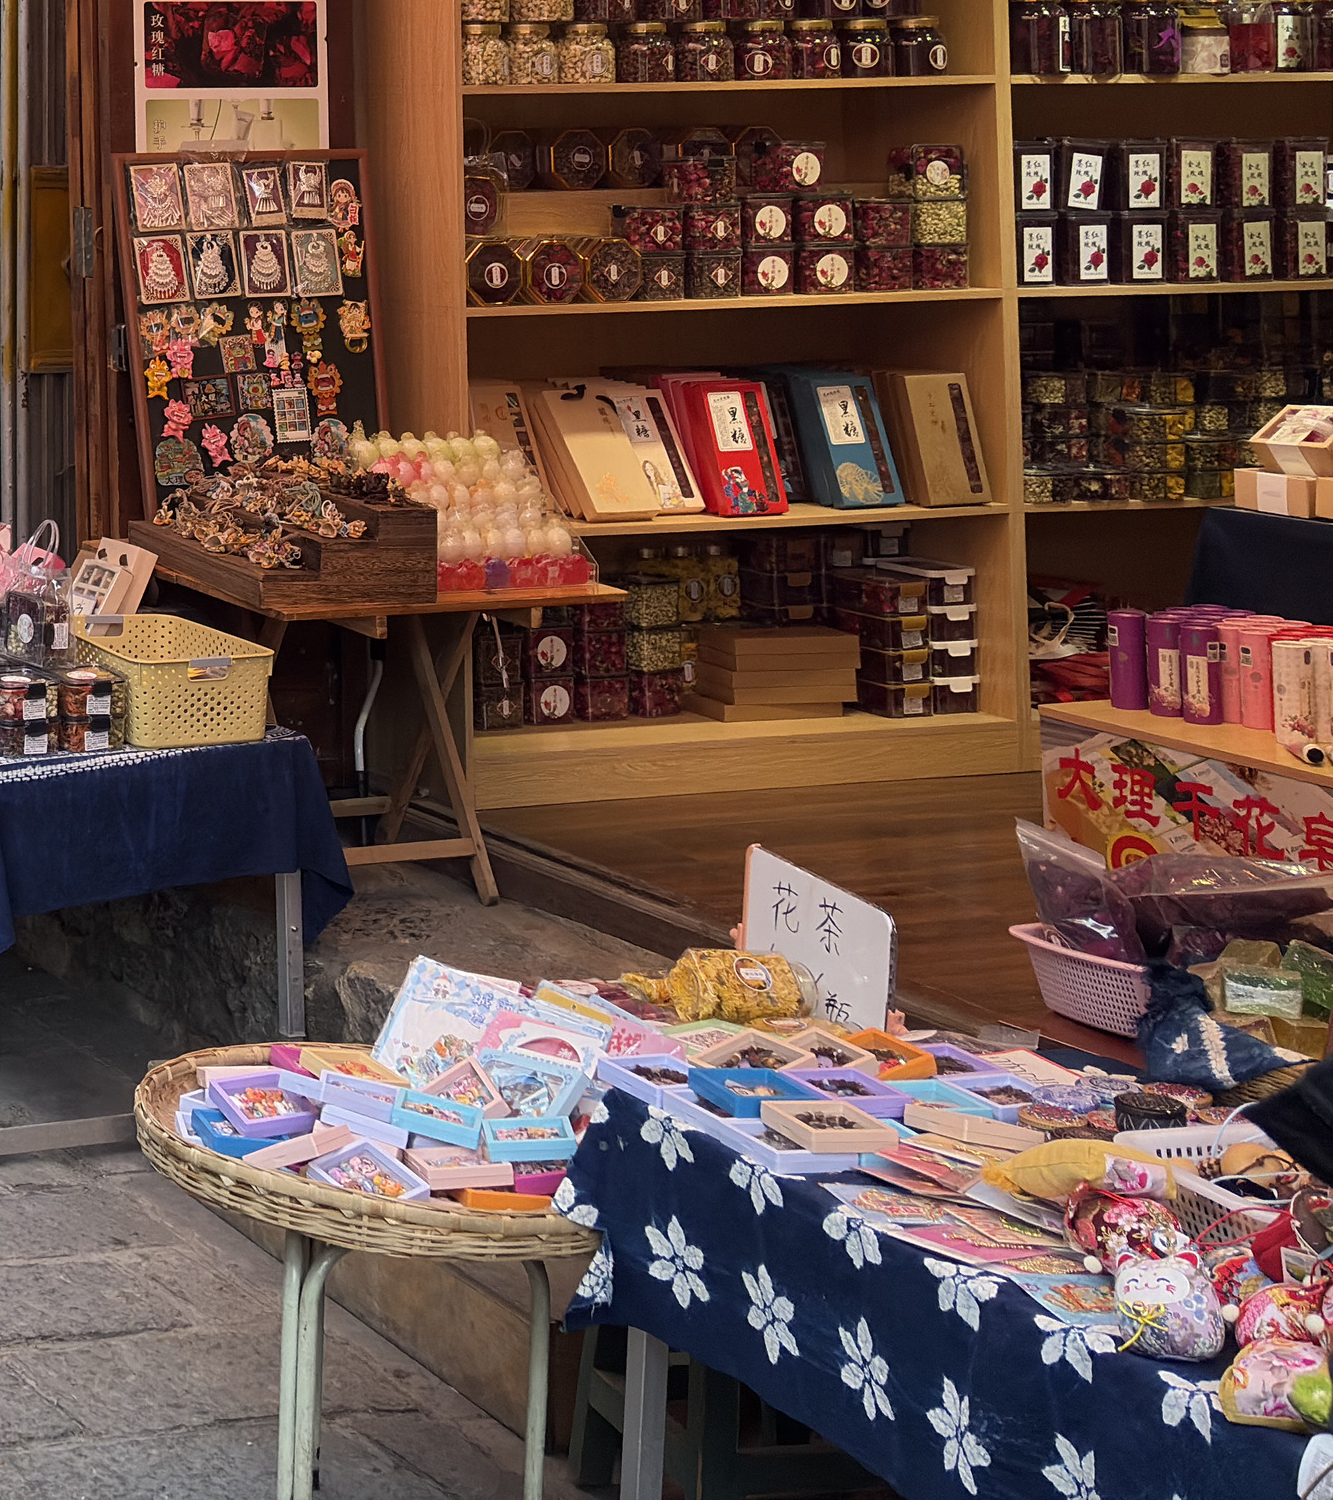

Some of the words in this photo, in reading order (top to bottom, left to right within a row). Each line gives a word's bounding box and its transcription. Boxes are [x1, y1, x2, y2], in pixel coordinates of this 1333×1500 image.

[150, 14, 165, 77] 玫瑰红糖
[728, 406, 748, 445] 黑糖
[838, 399, 860, 439] 黑糖
[772, 880, 844, 956] 花茶
